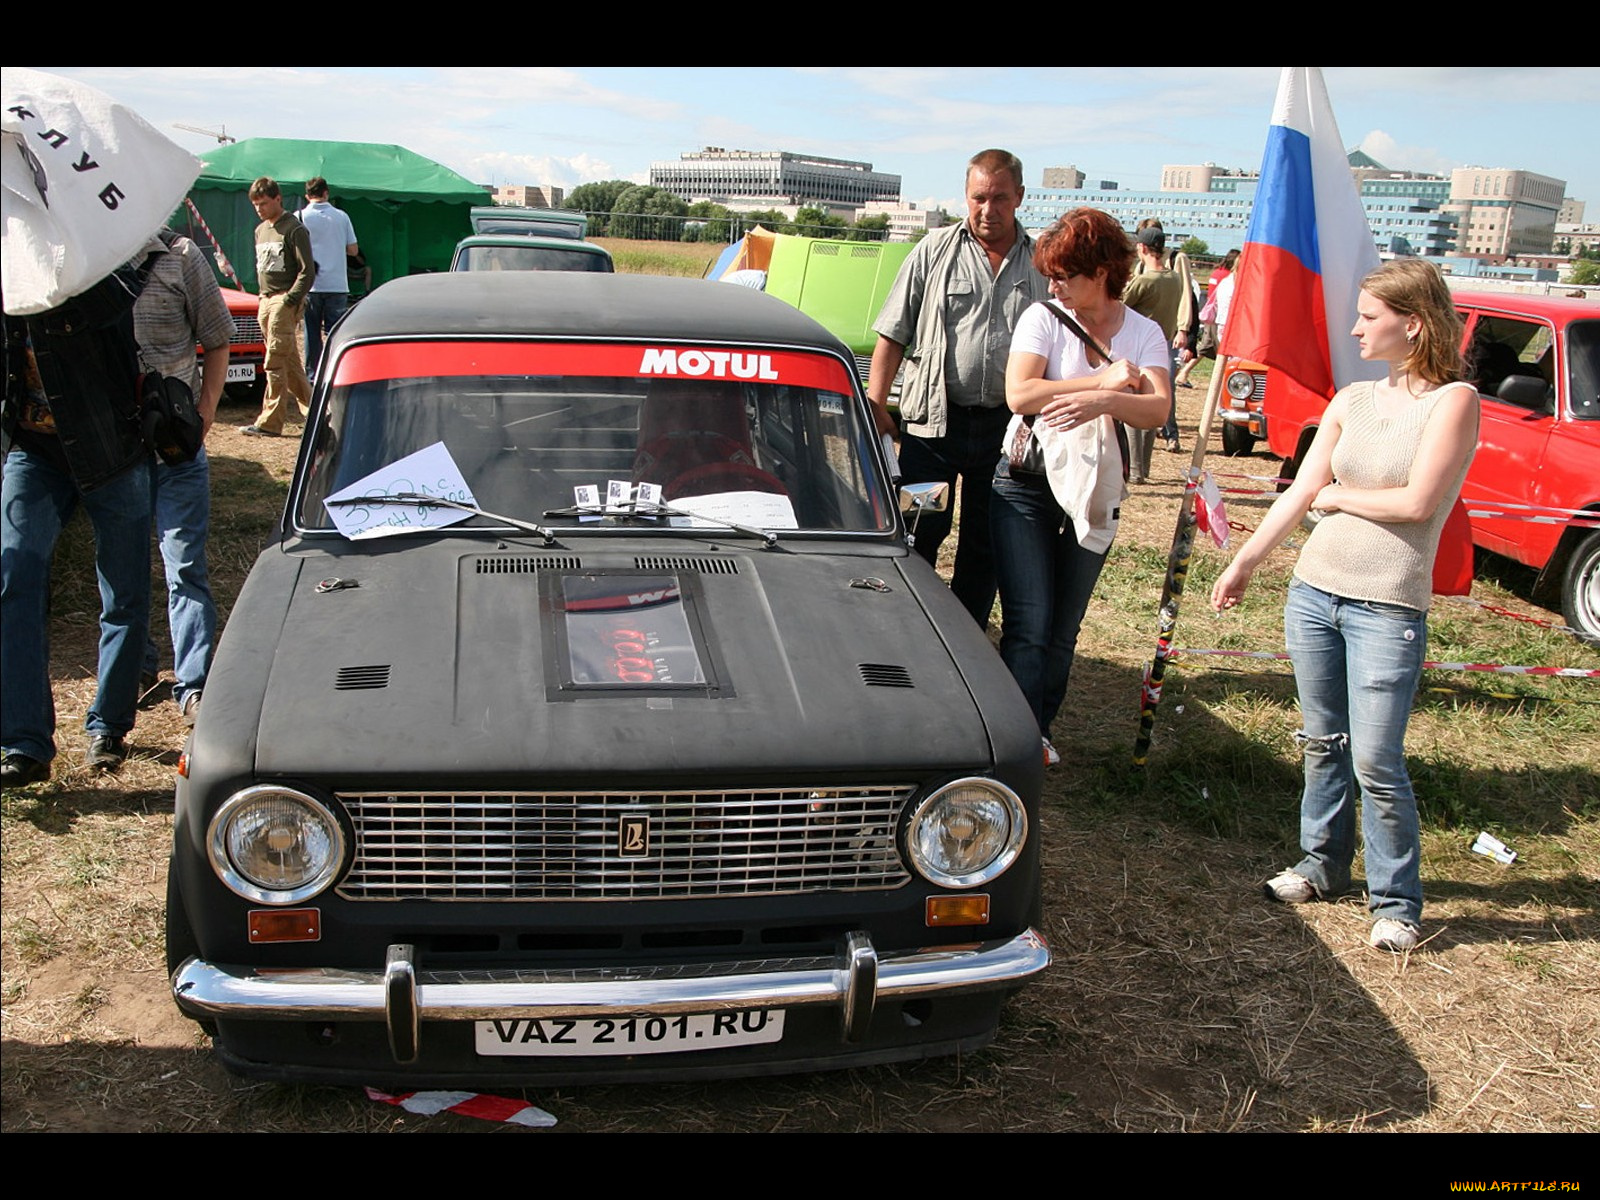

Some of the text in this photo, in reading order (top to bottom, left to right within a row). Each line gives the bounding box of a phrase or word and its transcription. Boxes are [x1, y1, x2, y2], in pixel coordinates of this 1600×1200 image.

[7, 105, 126, 210] КЛУБ
[639, 348, 779, 380] MOTUL
[492, 1010, 769, 1044] VAZ 2101.RU
